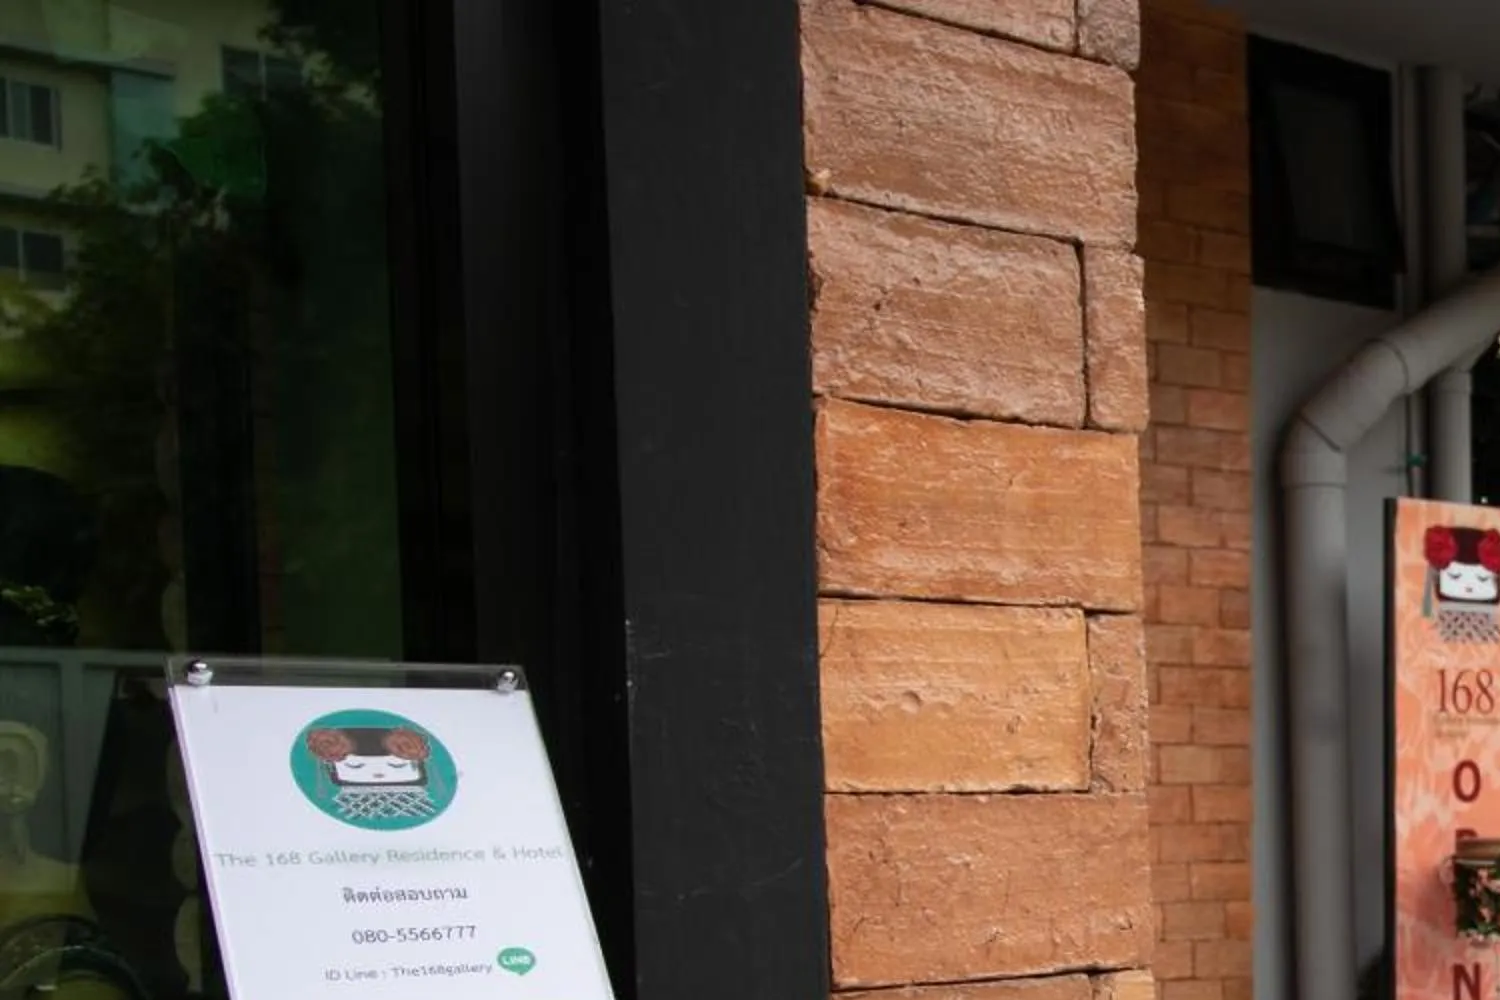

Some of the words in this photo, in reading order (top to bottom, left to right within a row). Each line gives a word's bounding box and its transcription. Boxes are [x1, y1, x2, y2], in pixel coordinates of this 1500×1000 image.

[1438, 668, 1495, 715] 168
[217, 852, 257, 868] The
[265, 850, 301, 867] 168
[308, 849, 380, 866] Gallery
[386, 846, 486, 863] Residence
[493, 846, 506, 861] &
[512, 845, 563, 861] Hotel
[351, 924, 477, 945] 080-5566777
[325, 969, 341, 982] ID
[345, 967, 379, 982] Line
[390, 962, 493, 979] The168gallery
